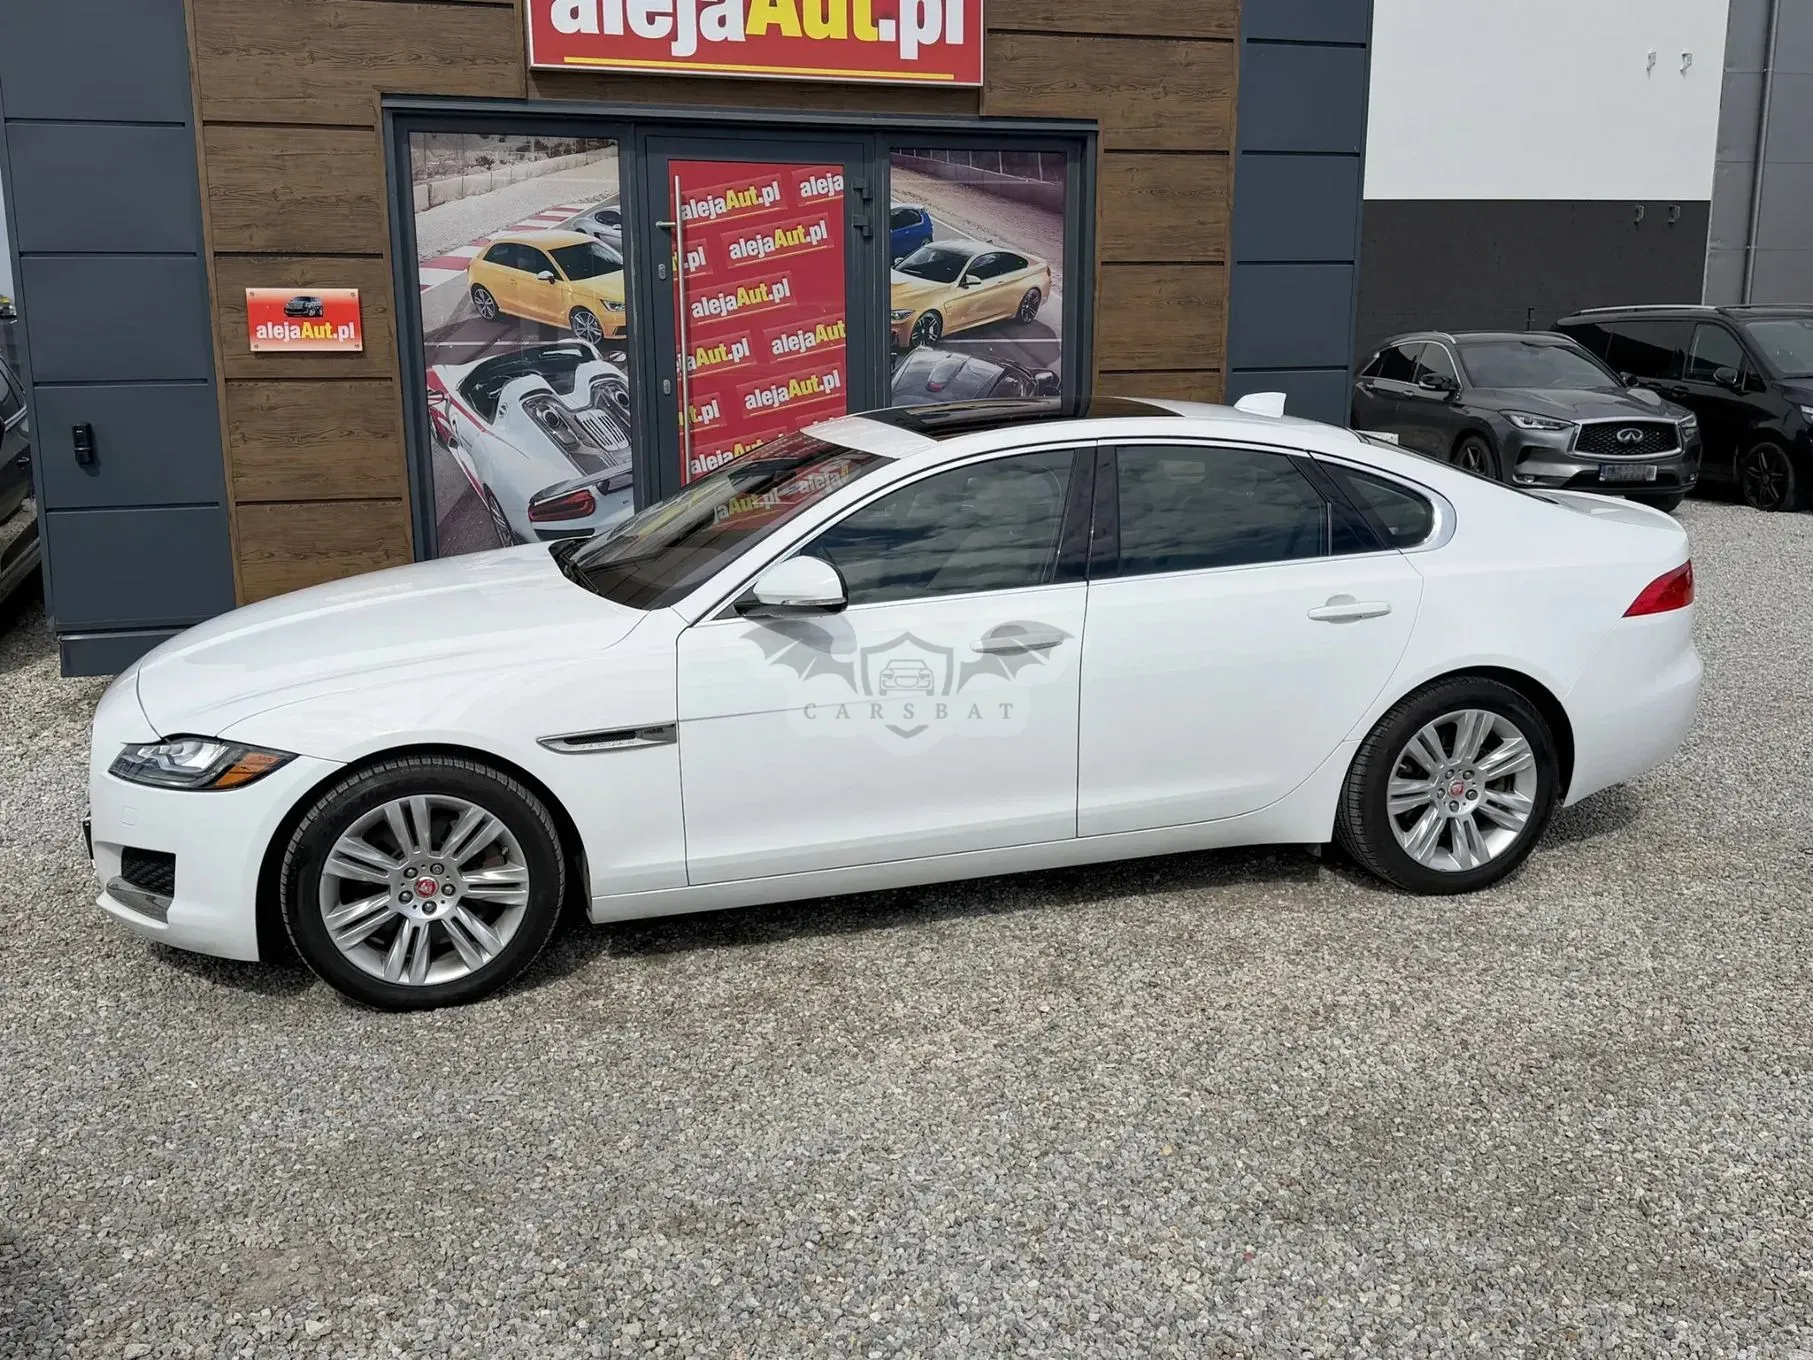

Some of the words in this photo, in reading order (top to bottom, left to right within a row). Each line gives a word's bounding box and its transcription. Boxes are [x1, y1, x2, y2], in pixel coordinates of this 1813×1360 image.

[551, 0, 964, 60] alejaAut.pl
[681, 181, 781, 220] alejaAut.pl
[800, 172, 844, 197] aleja
[729, 220, 828, 260] alejaAut.pl
[691, 278, 791, 318] alejaAut.pl
[256, 321, 355, 342] alejaAut.pl
[744, 369, 841, 411] alejaAut.pl
